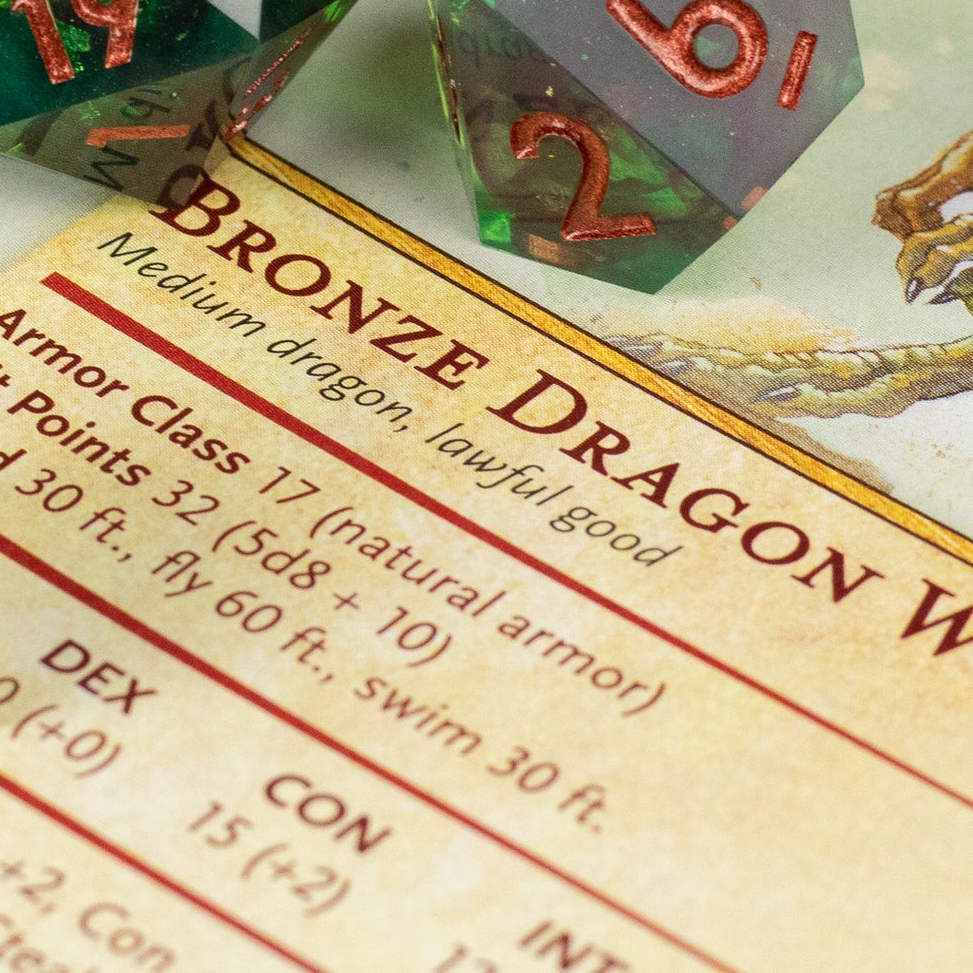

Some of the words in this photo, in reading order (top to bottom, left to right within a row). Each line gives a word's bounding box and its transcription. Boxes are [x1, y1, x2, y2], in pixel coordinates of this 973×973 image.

[508, 110, 658, 243] 2
[97, 231, 267, 338] Medium
[266, 336, 415, 436] dragon,
[424, 421, 576, 508] lawful
[549, 505, 686, 569] good
[148, 173, 491, 392] BRONZE
[486, 368, 887, 607] DRAGON
[7, 388, 152, 488] Points
[152, 478, 221, 528] 32
[211, 519, 332, 591] (5d8
[332, 590, 361, 613] +
[375, 604, 455, 670] 10)
[129, 392, 253, 477] Class
[257, 465, 323, 506] 17
[308, 505, 509, 622] (natural
[495, 610, 668, 720] armor)
[14, 467, 85, 514] 30
[79, 505, 133, 564] ft.,
[150, 548, 214, 599] fly
[214, 588, 284, 635] 60
[279, 625, 334, 685] ft.,
[351, 672, 484, 758] swim
[486, 744, 560, 795] 30
[557, 782, 604, 835] ft.
[39, 638, 158, 717] DEX
[11, 702, 124, 780] (+0)
[187, 799, 255, 850] 15
[239, 842, 352, 919] (+2)
[262, 771, 394, 856] CON
[75, 900, 177, 973] Con
